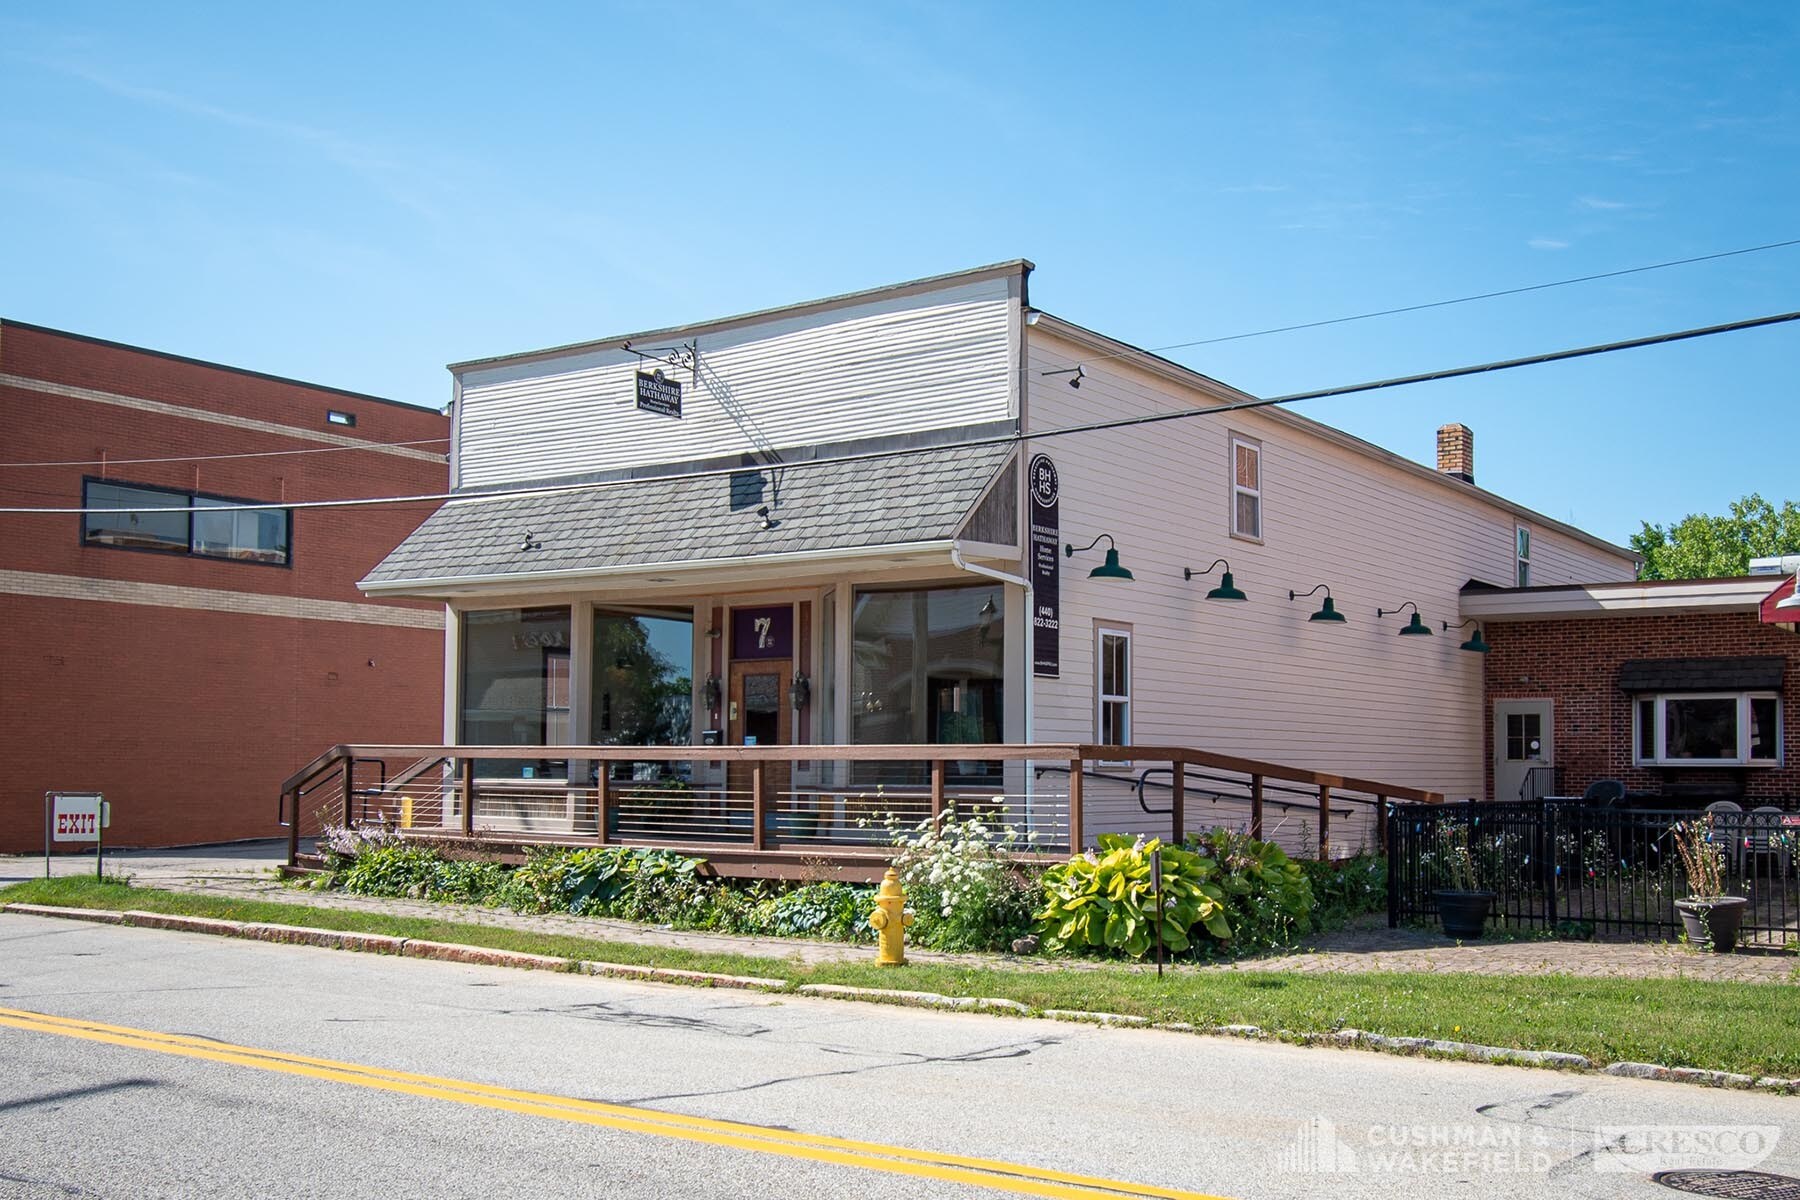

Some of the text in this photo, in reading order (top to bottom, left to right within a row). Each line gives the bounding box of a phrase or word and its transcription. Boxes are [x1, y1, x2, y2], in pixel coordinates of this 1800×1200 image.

[638, 379, 681, 397] BERKSHIRE
[640, 388, 679, 404] HATHAWAY
[1039, 468, 1051, 481] BH
[1039, 481, 1051, 494] HS
[1039, 606, 1053, 618] (440)
[1034, 617, 1058, 629] 822-3222
[754, 618, 771, 648] 7
[58, 814, 95, 834] EXIT
